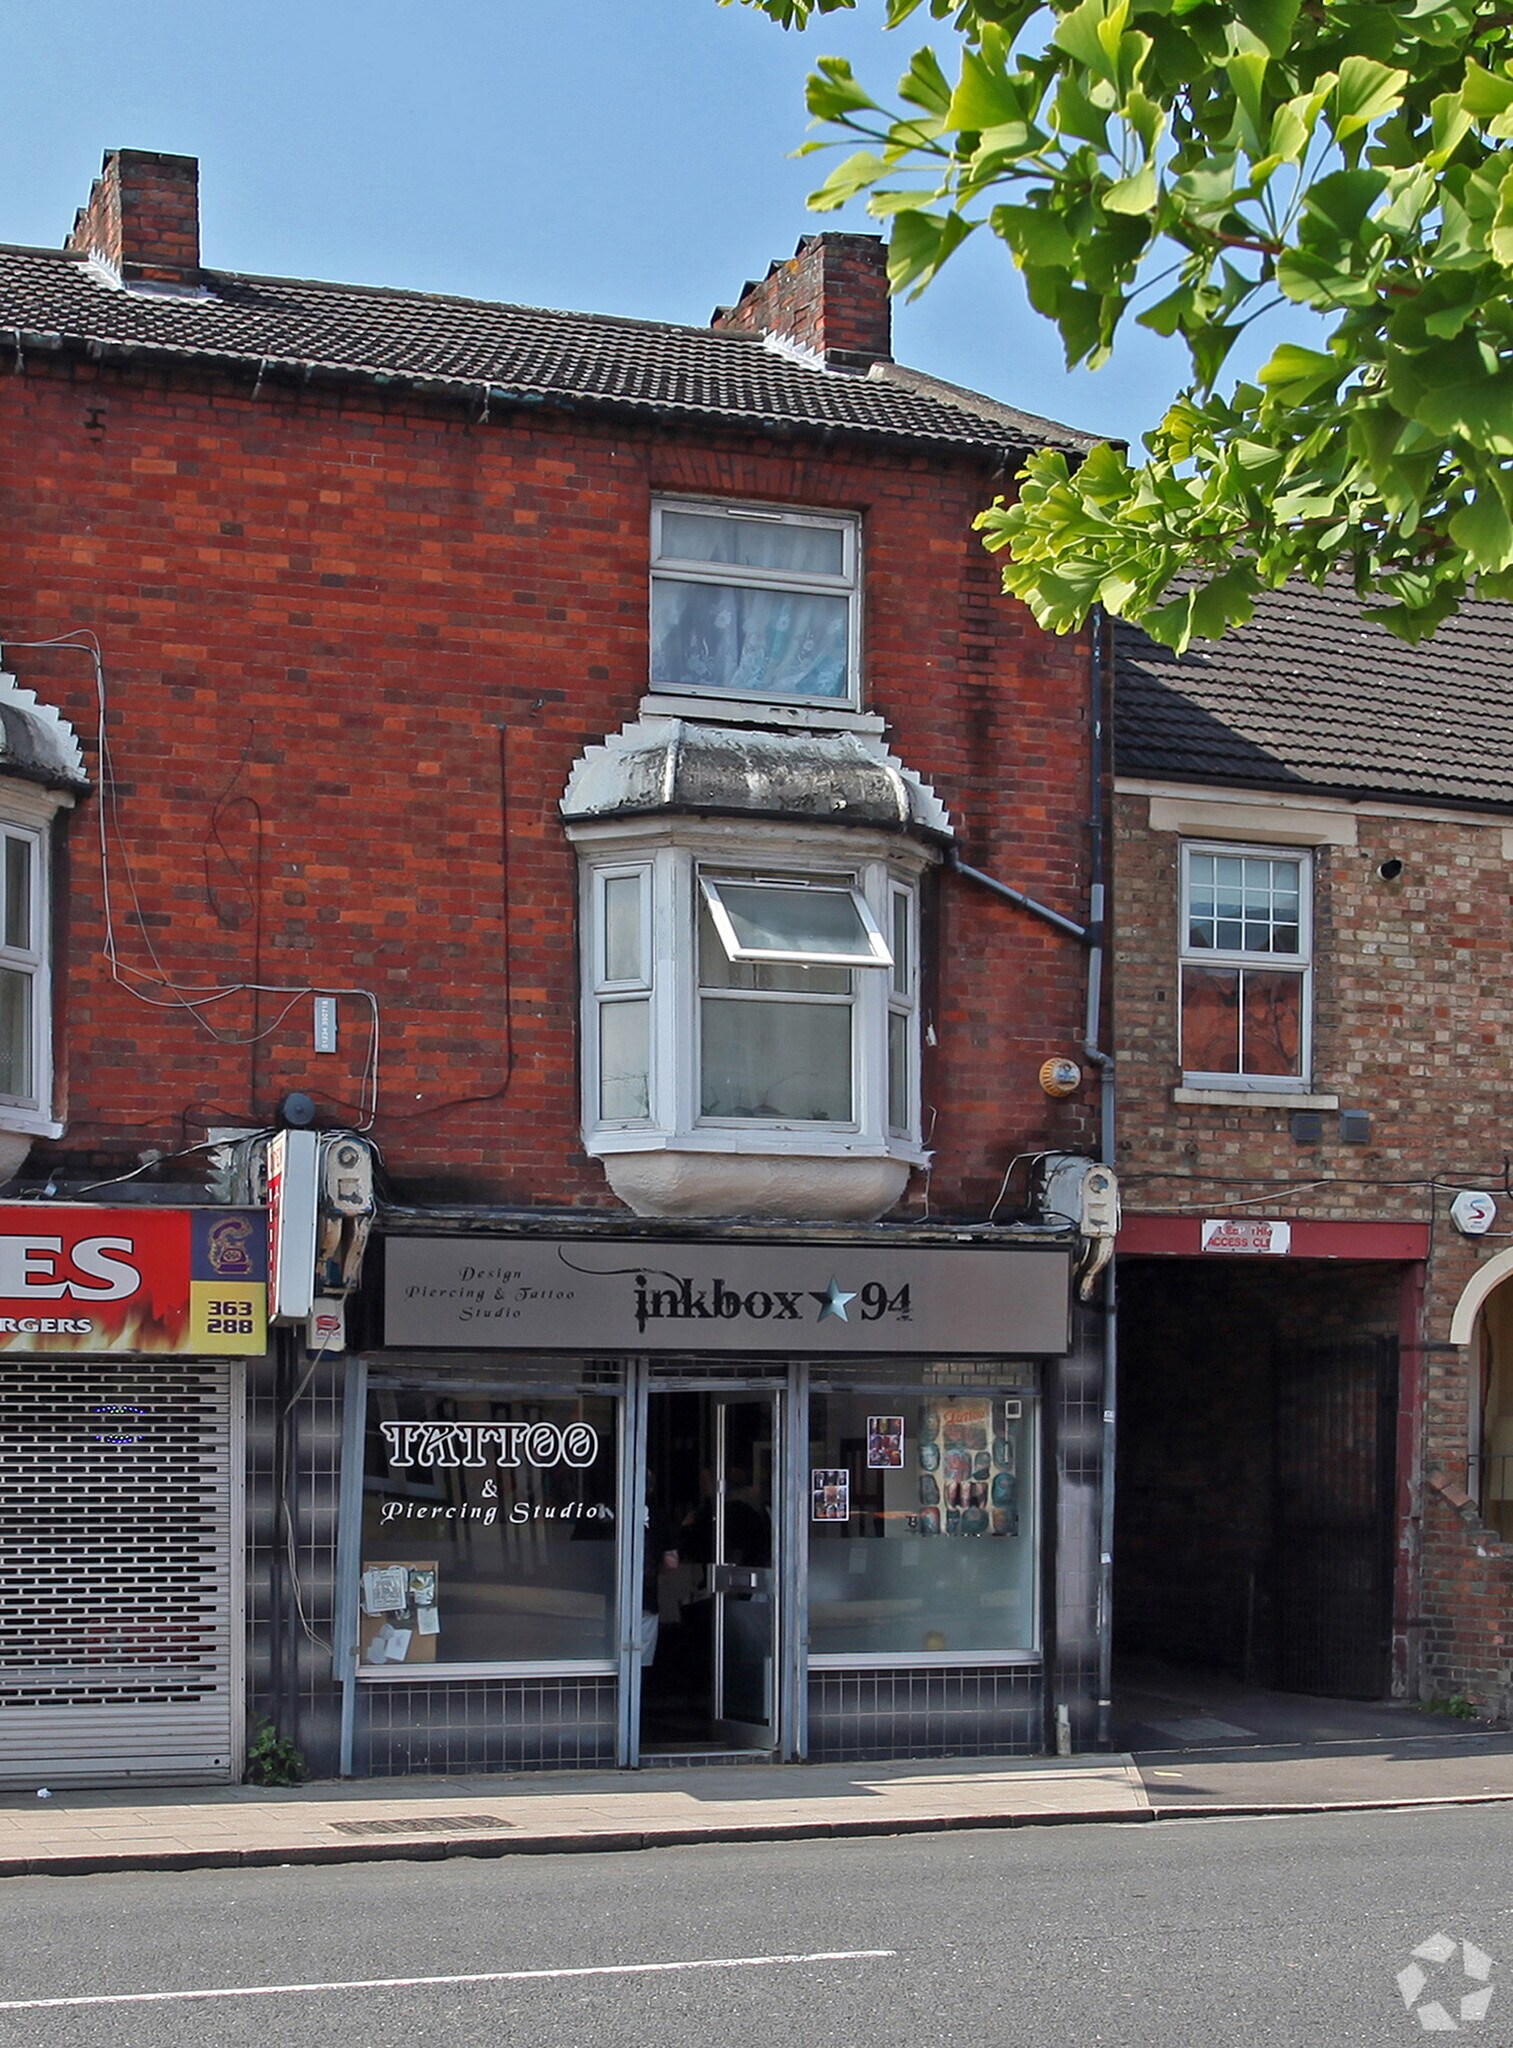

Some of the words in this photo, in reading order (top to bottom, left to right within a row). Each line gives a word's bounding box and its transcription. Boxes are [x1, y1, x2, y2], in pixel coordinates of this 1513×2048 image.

[458, 1266, 523, 1284] Design
[405, 1285, 486, 1303] Piercing
[493, 1287, 505, 1301] &
[514, 1286, 576, 1301] Tattoo
[207, 1301, 253, 1316] 363
[633, 1275, 804, 1334] inkbox
[860, 1282, 914, 1322] 94
[458, 1306, 522, 1322] Studio
[207, 1318, 254, 1334] 288
[379, 1421, 599, 1468] TATTOO
[481, 1478, 498, 1499] &
[379, 1502, 499, 1526] Piercing
[509, 1502, 599, 1524] Studio
